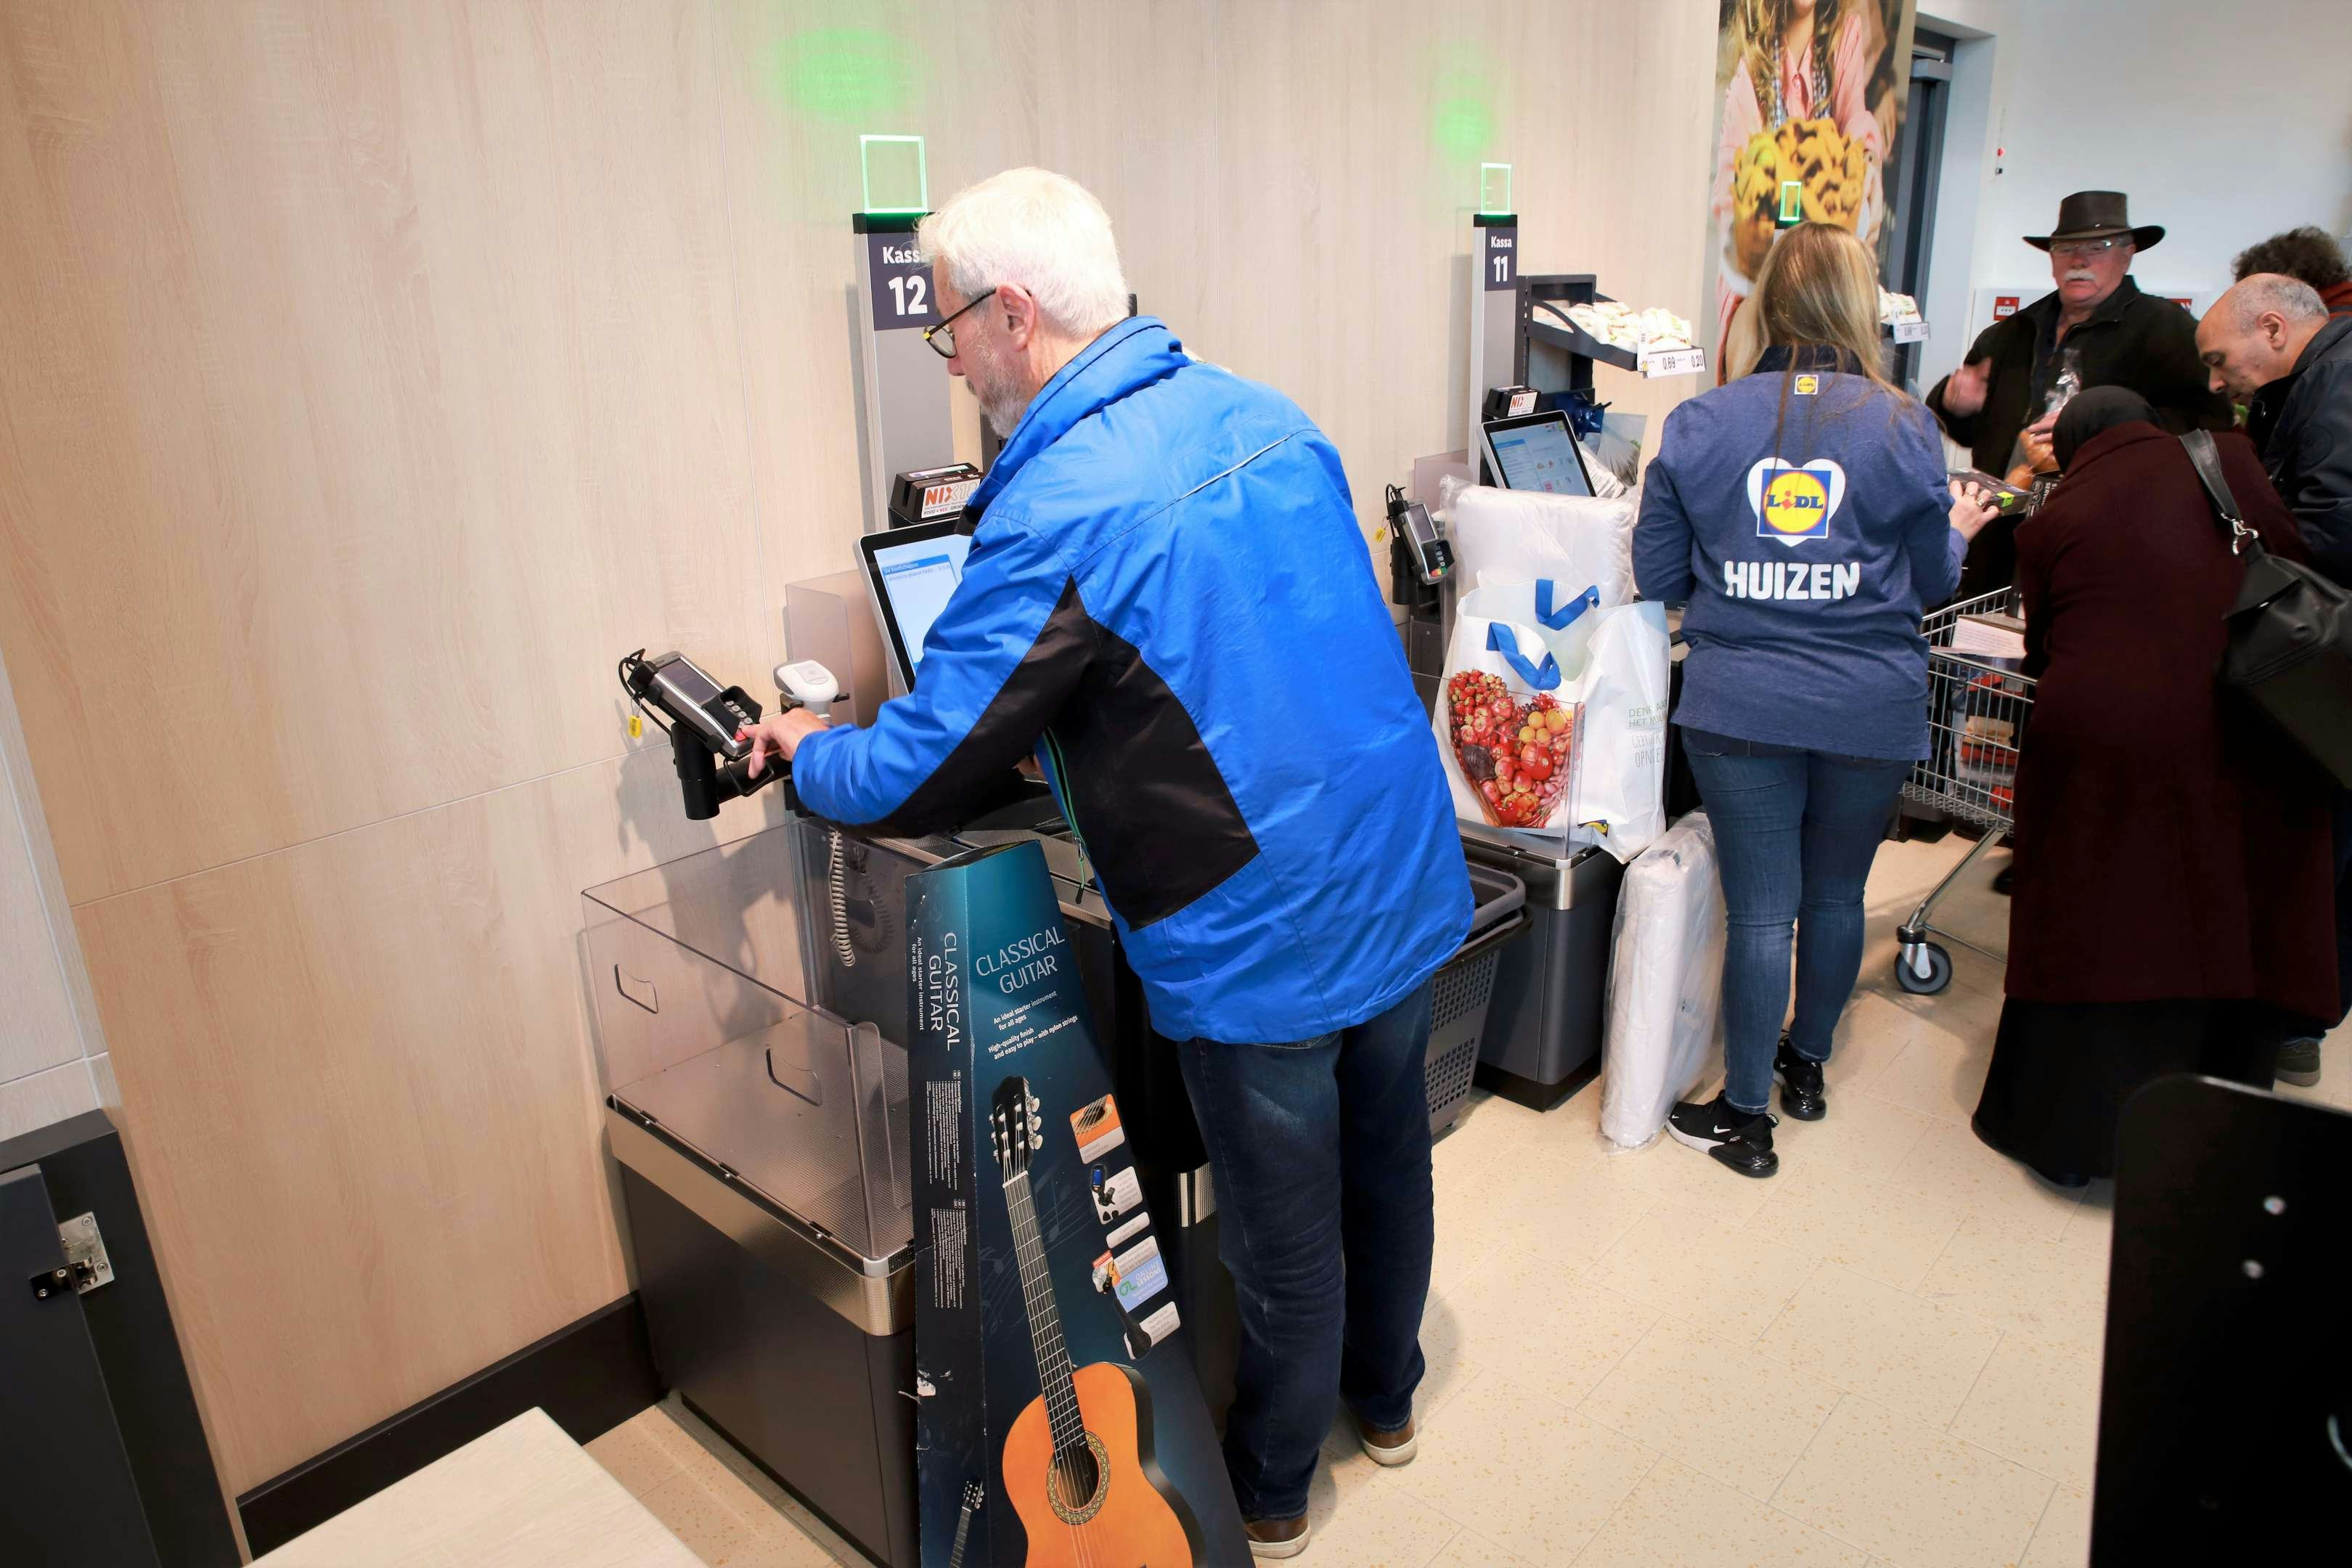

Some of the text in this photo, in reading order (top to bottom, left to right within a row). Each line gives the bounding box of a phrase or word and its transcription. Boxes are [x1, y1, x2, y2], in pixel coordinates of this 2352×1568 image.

[883, 246, 922, 264] Kass
[1491, 236, 1512, 248] Kassa
[1493, 256, 1508, 282] 11
[888, 275, 928, 316] 12
[1724, 560, 1860, 600] HUIZEN
[1628, 717, 1648, 727] HET
[917, 936, 923, 947] An
[976, 926, 1065, 976] CLASSICAL
[1000, 955, 1058, 994] GUITAR
[928, 955, 944, 1032] GUITAR
[944, 932, 960, 1051] CLASSICAL
[1001, 1010, 1015, 1021] ideal
[1015, 1003, 1031, 1015] starter
[1031, 991, 1058, 1007] instrument
[994, 1050, 1005, 1060] and
[1005, 1045, 1017, 1055] easy
[1024, 1037, 1034, 1047] play
[1037, 1029, 1049, 1039] with
[1049, 1022, 1062, 1034] nylon
[1062, 1015, 1078, 1027] strings
[998, 1022, 1008, 1031] for
[1015, 1014, 1027, 1024] ages
[988, 1027, 1034, 1053] High-quality finish
